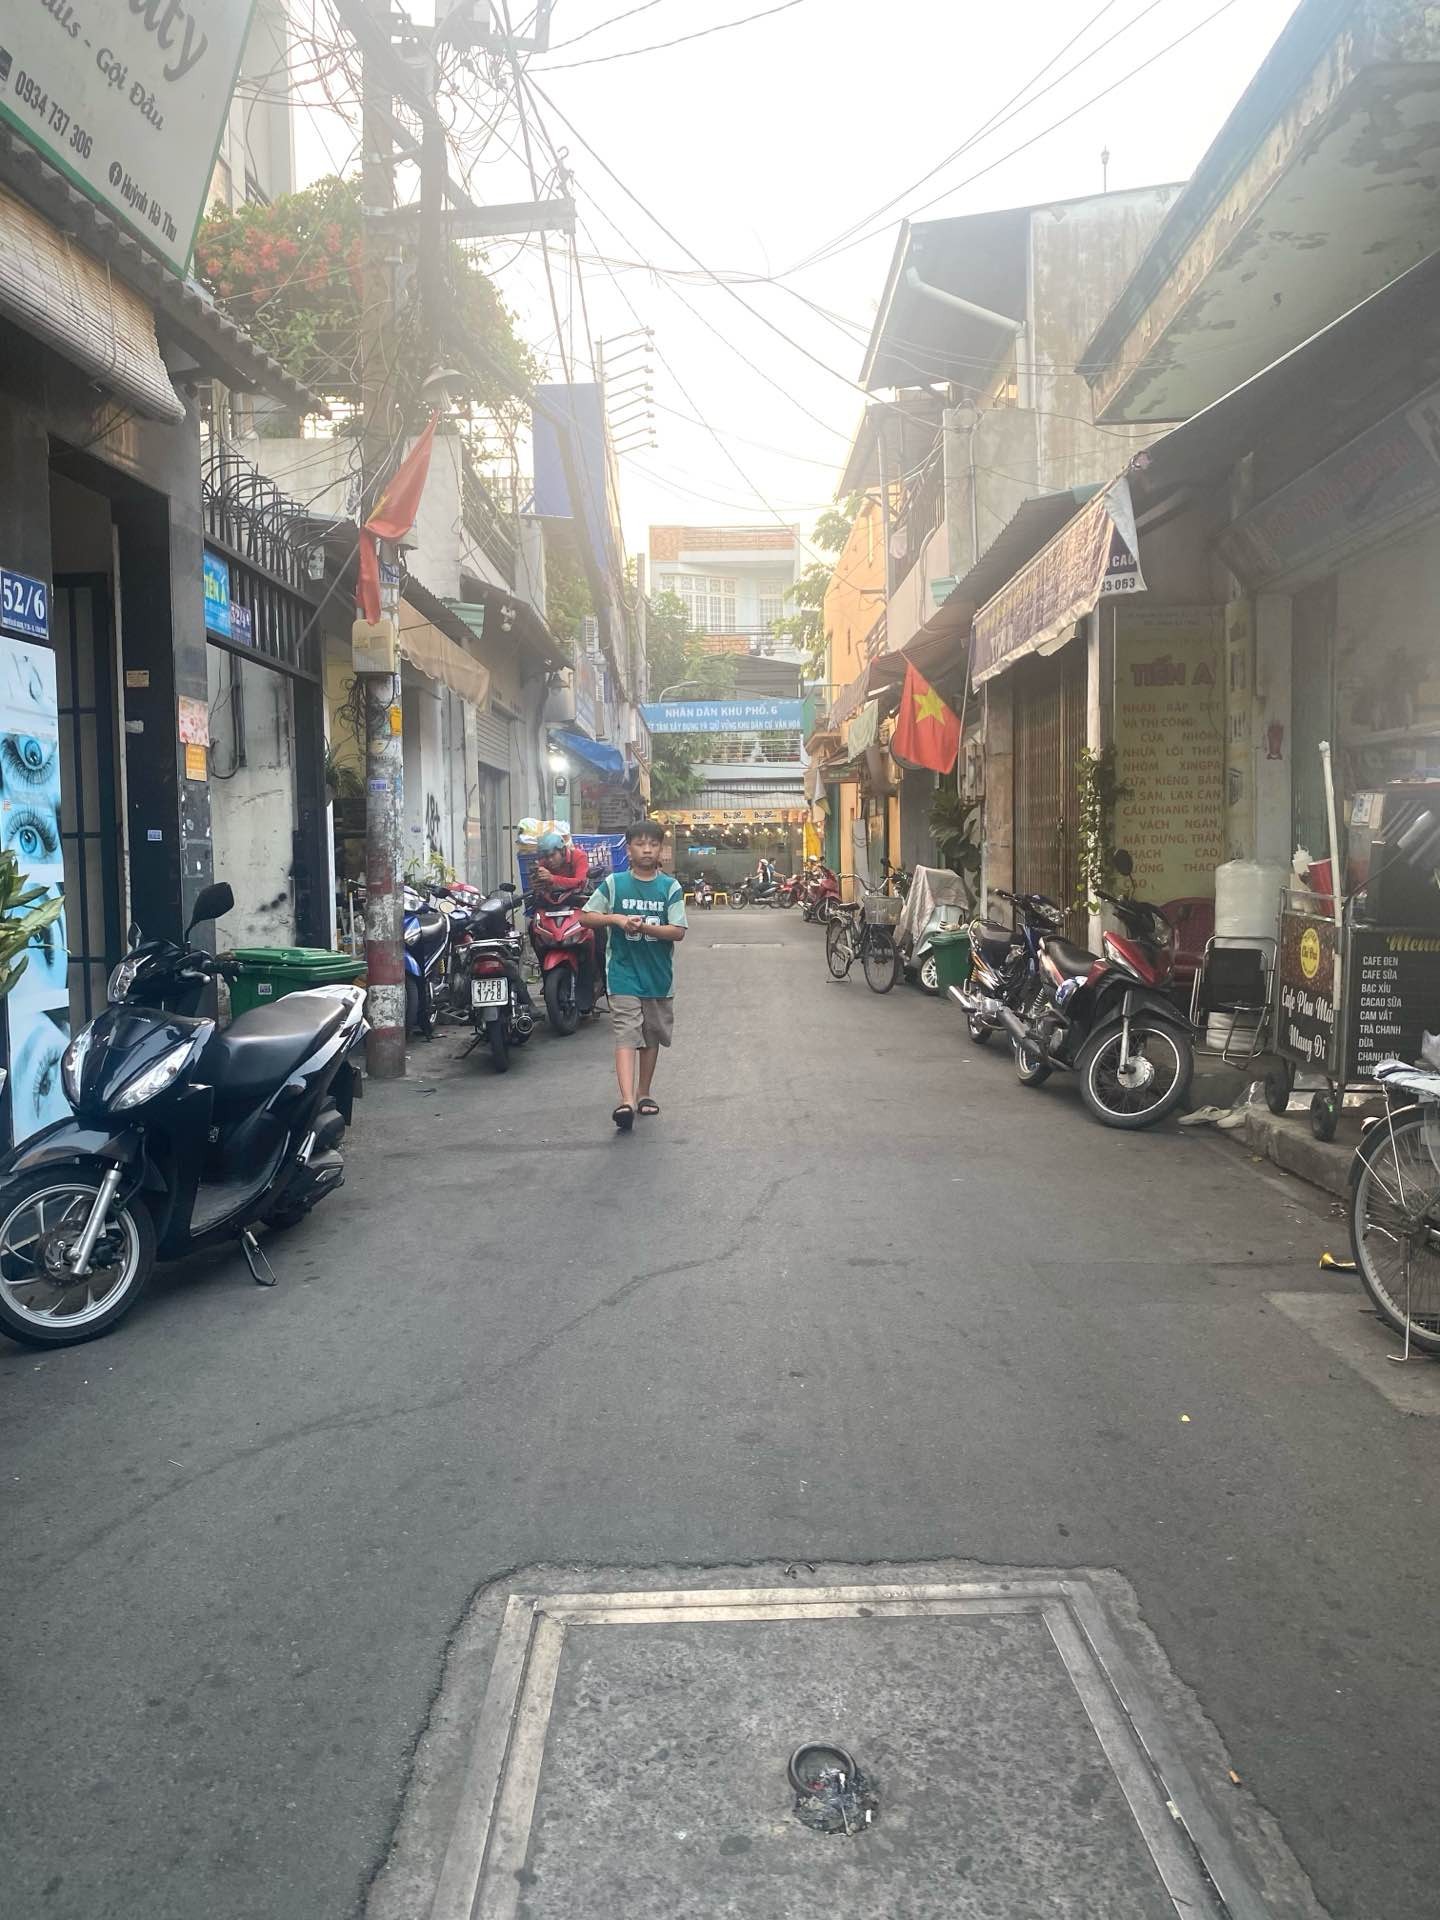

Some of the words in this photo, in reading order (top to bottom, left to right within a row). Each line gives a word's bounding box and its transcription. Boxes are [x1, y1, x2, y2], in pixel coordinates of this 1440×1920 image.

[96, 48, 129, 90] Gội
[129, 81, 164, 131] Đầu
[15, 71, 49, 118] 0934
[48, 101, 71, 137] 737
[70, 124, 93, 159] 306
[120, 173, 148, 217] Huỳnh
[3, 578, 45, 620] 52/6
[665, 707, 694, 719] NHÂN
[696, 706, 718, 717] DÂN
[721, 705, 743, 717] KHU
[771, 705, 778, 715] 6
[1150, 803, 1189, 815] THANG
[1129, 848, 1162, 861] HẠCH
[1362, 956, 1382, 966] CAFE
[1362, 970, 1381, 980] CAFE
[1360, 997, 1386, 1007] CACAO
[1360, 1010, 1377, 1021] CAM
[1359, 1024, 1374, 1034] TRÀ
[1375, 1025, 1401, 1035] CHANH
[1358, 1051, 1383, 1062] CHANH
